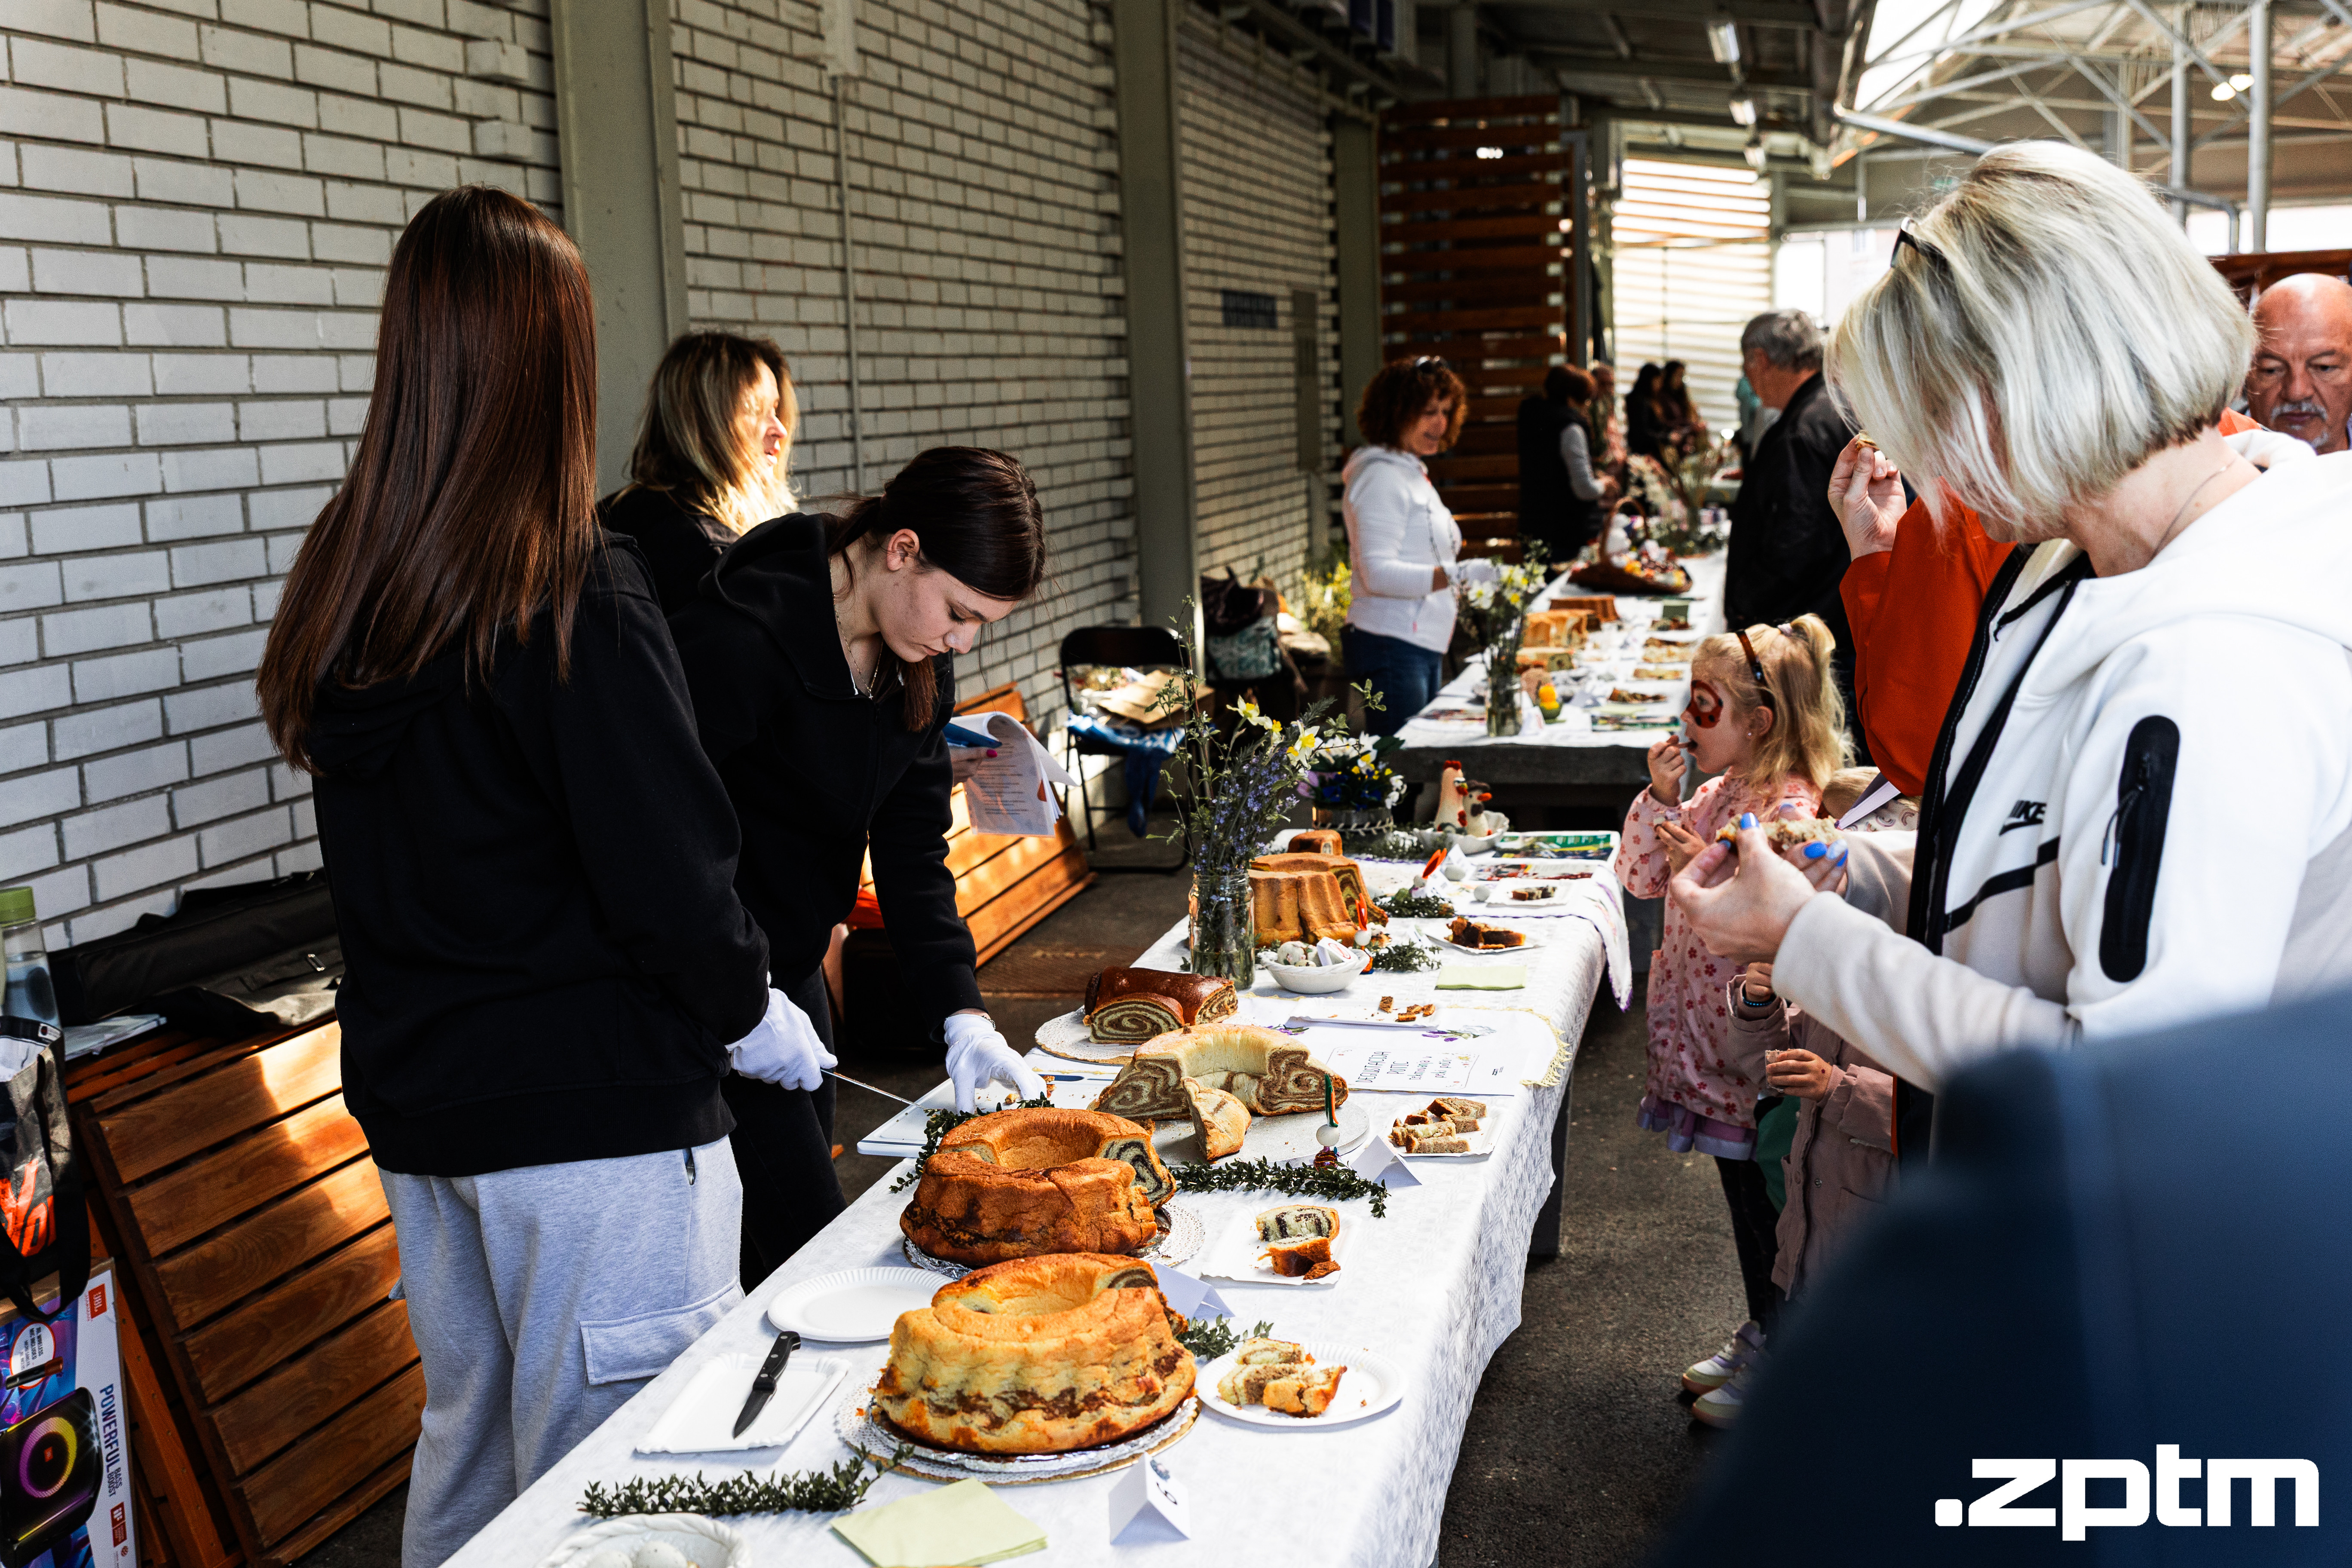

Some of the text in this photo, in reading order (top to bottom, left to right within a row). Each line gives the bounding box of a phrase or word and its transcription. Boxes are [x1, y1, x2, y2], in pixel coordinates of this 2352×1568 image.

[2008, 800, 2046, 824] NIKE
[1355, 1051, 1391, 1082] DEGUSTACIJA
[1387, 1061, 1409, 1074] POTIC
[93, 1291, 103, 1312] JBL
[99, 1383, 120, 1473] POWERFUL
[107, 1471, 116, 1497] BOOST
[113, 1467, 122, 1489] BASS
